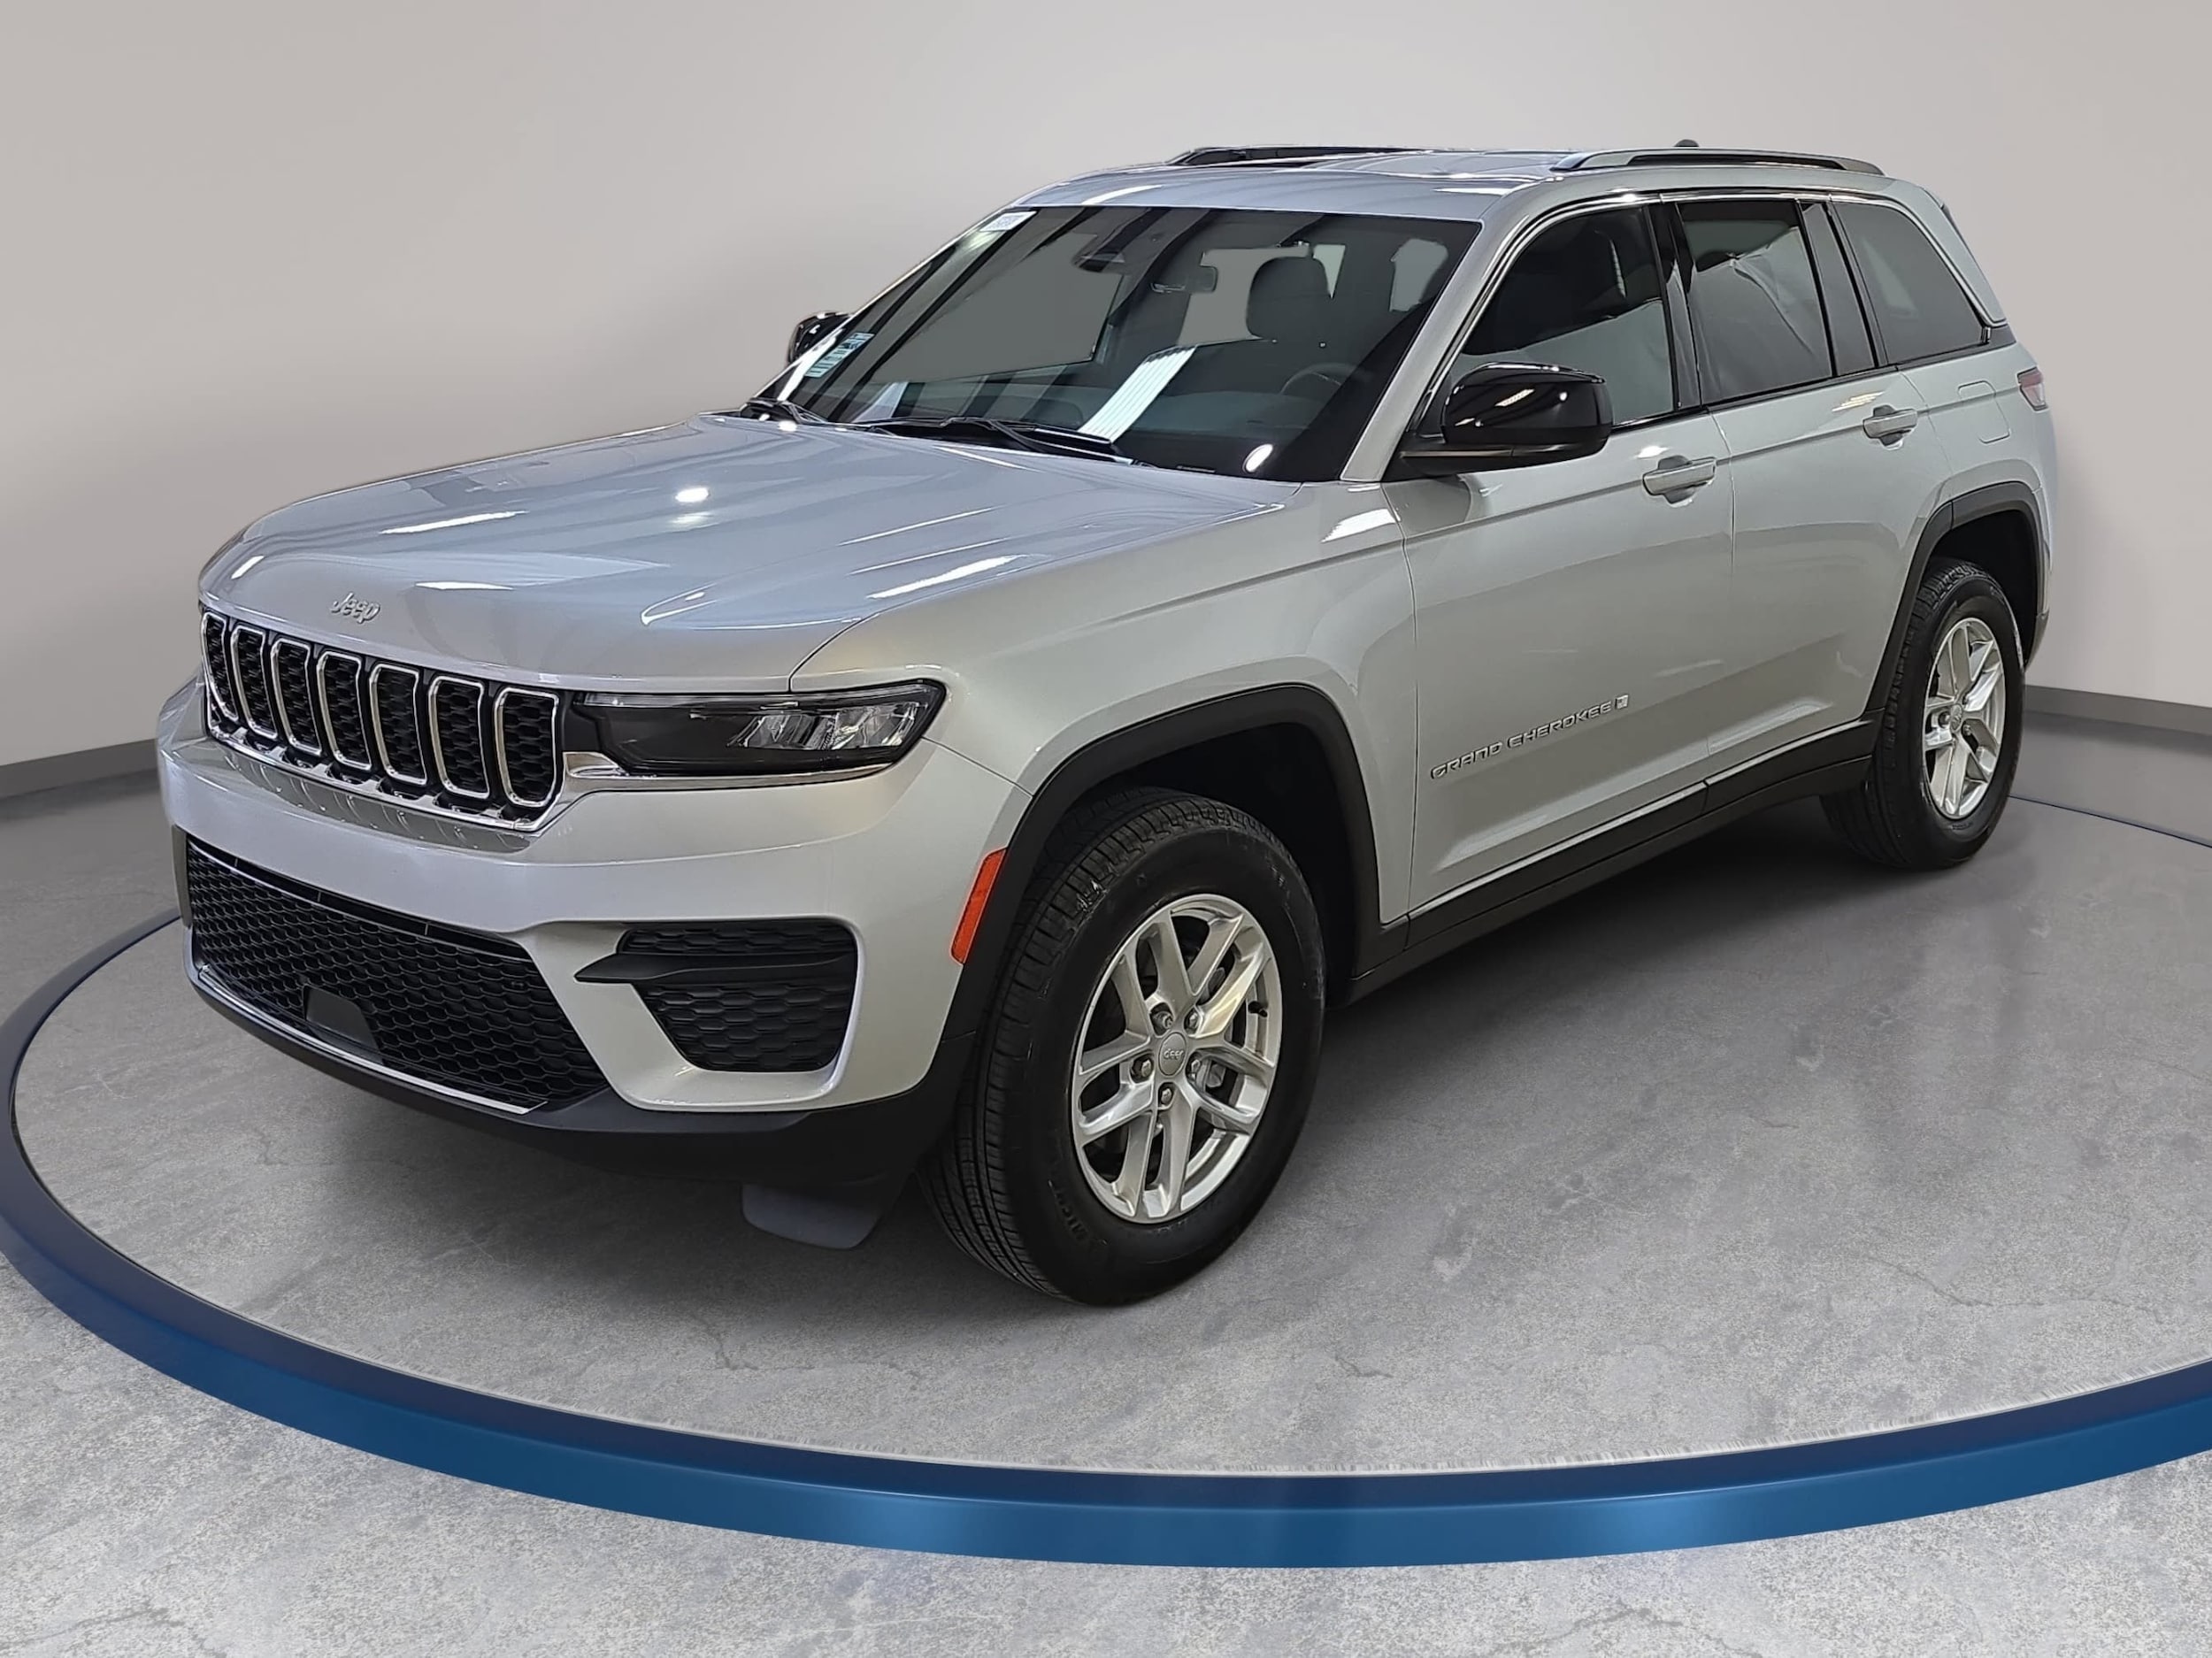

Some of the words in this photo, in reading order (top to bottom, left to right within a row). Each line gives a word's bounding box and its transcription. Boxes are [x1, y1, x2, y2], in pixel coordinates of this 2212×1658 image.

[330, 592, 380, 625] Jeep
[1431, 742, 1502, 779] GRAND
[1508, 701, 1611, 748] CHEROKEE
